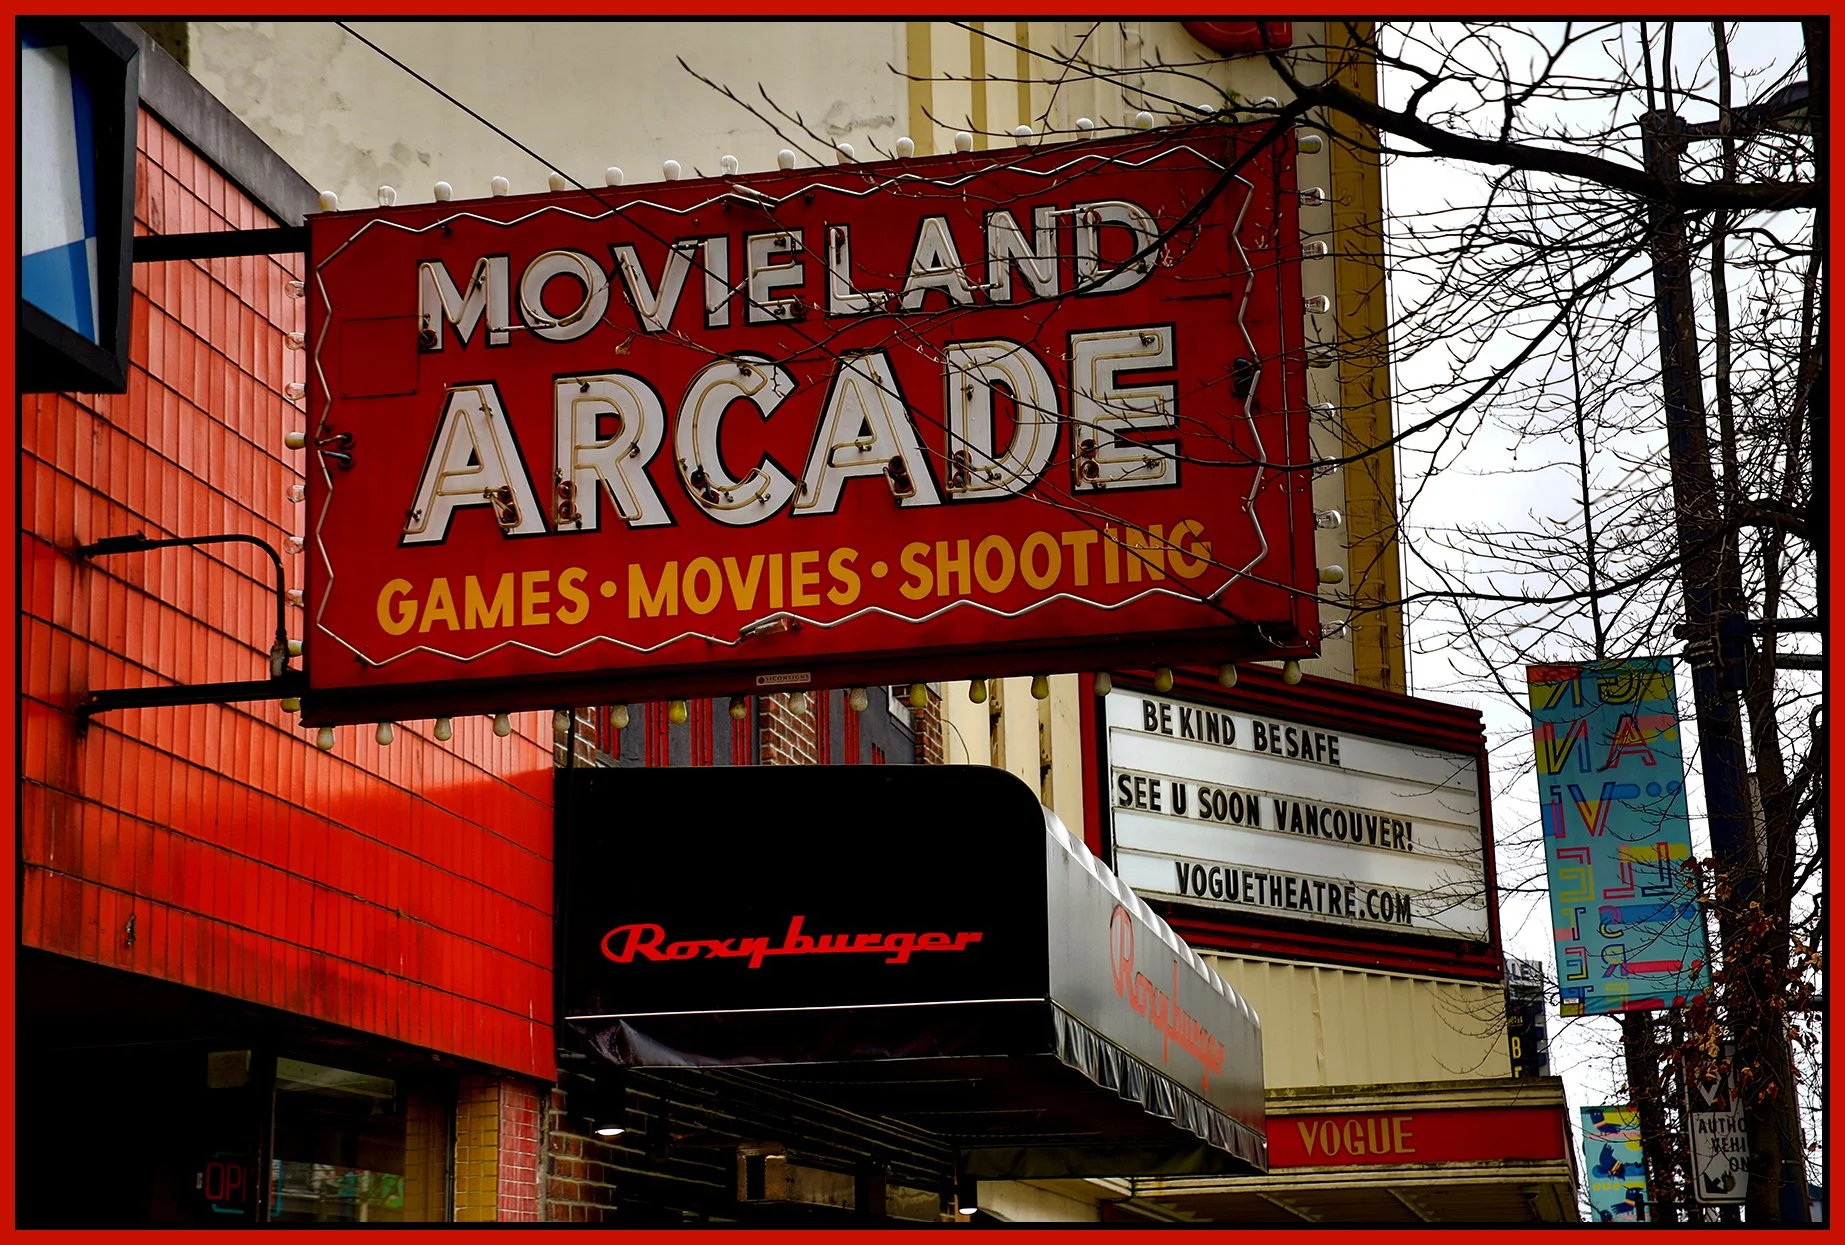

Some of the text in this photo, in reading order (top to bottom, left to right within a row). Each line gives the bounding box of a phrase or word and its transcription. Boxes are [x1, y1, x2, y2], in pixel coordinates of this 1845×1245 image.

[418, 203, 1163, 350] MOVIELAND
[402, 326, 1180, 544] ARCADE
[376, 519, 1212, 636] GAMES MOVIES SHOOTING
[1143, 700, 1172, 734] BE
[1180, 706, 1235, 746] KIND
[1117, 774, 1413, 851] SEE U SOON VANCOUVER!
[1175, 862, 1411, 924] VOGUETHEATRE.COM
[1297, 1116, 1415, 1156] VOGUE
